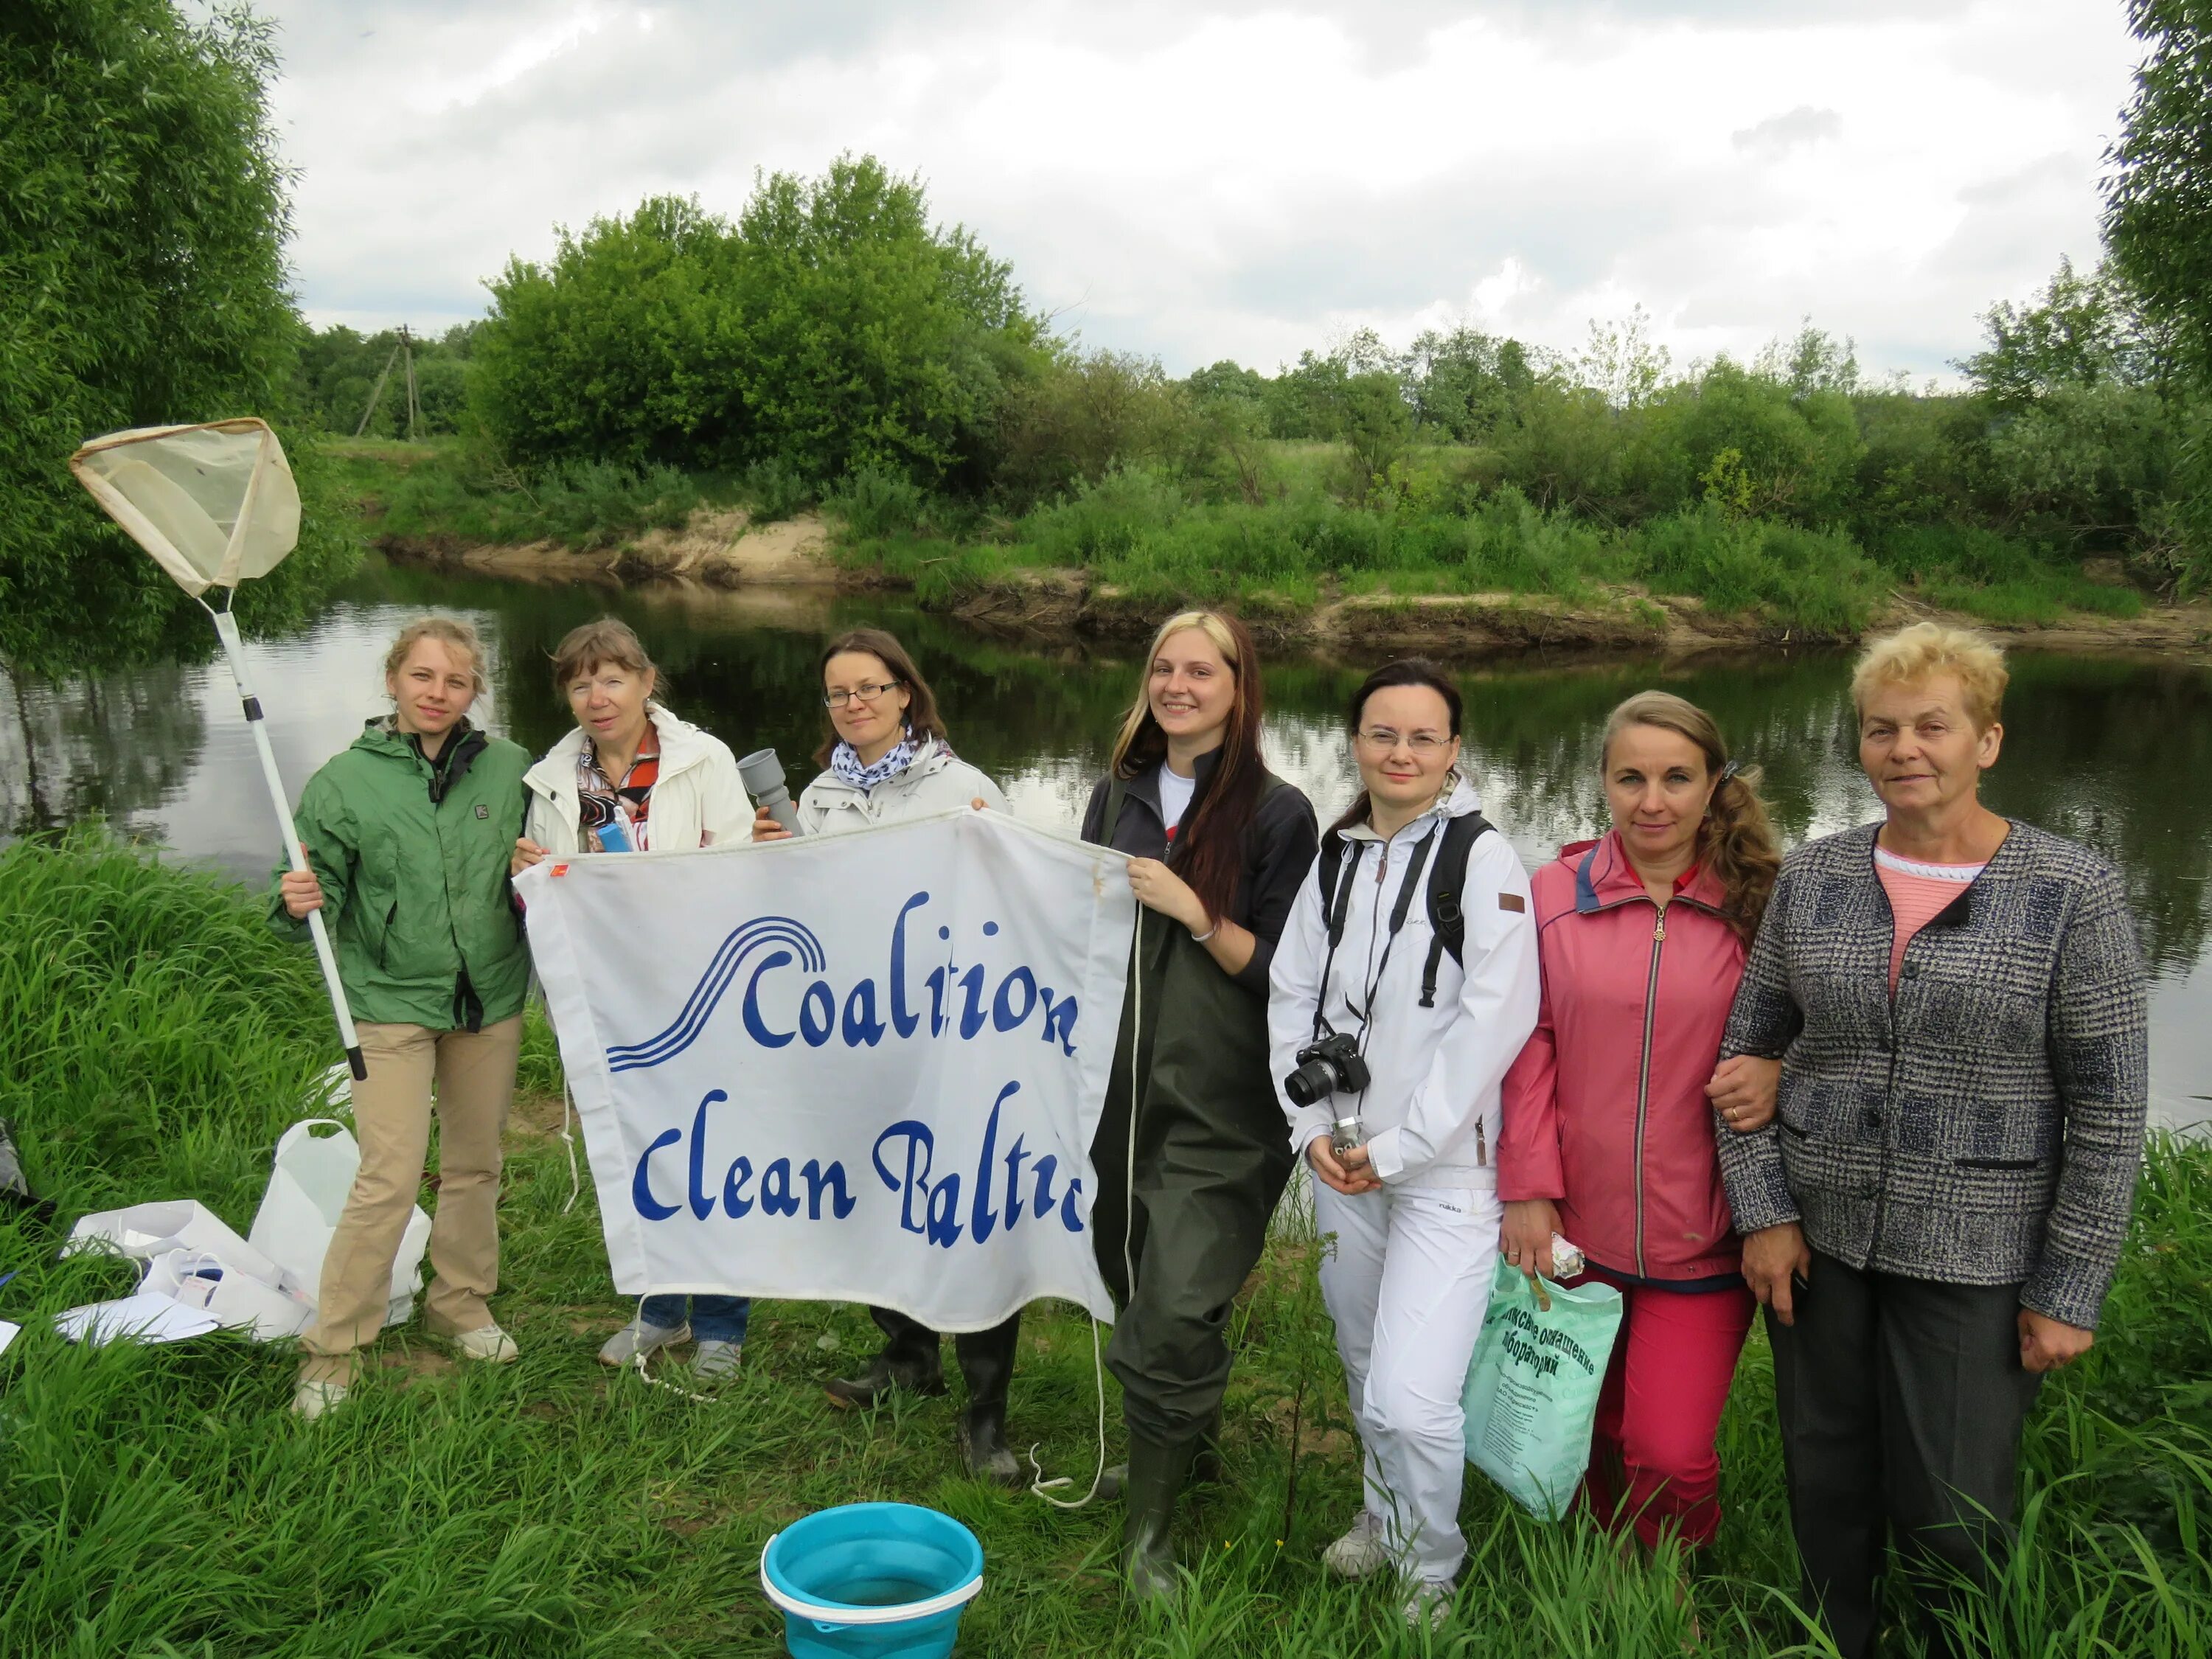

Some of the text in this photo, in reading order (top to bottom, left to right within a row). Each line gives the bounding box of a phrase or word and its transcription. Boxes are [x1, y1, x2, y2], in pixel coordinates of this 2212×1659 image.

[742, 892, 1078, 1057] Coalition
[633, 1080, 1084, 1248] Clean Baltic
[1439, 1203, 1462, 1214] rukka
[1502, 1330, 1559, 1379] лбораторий
